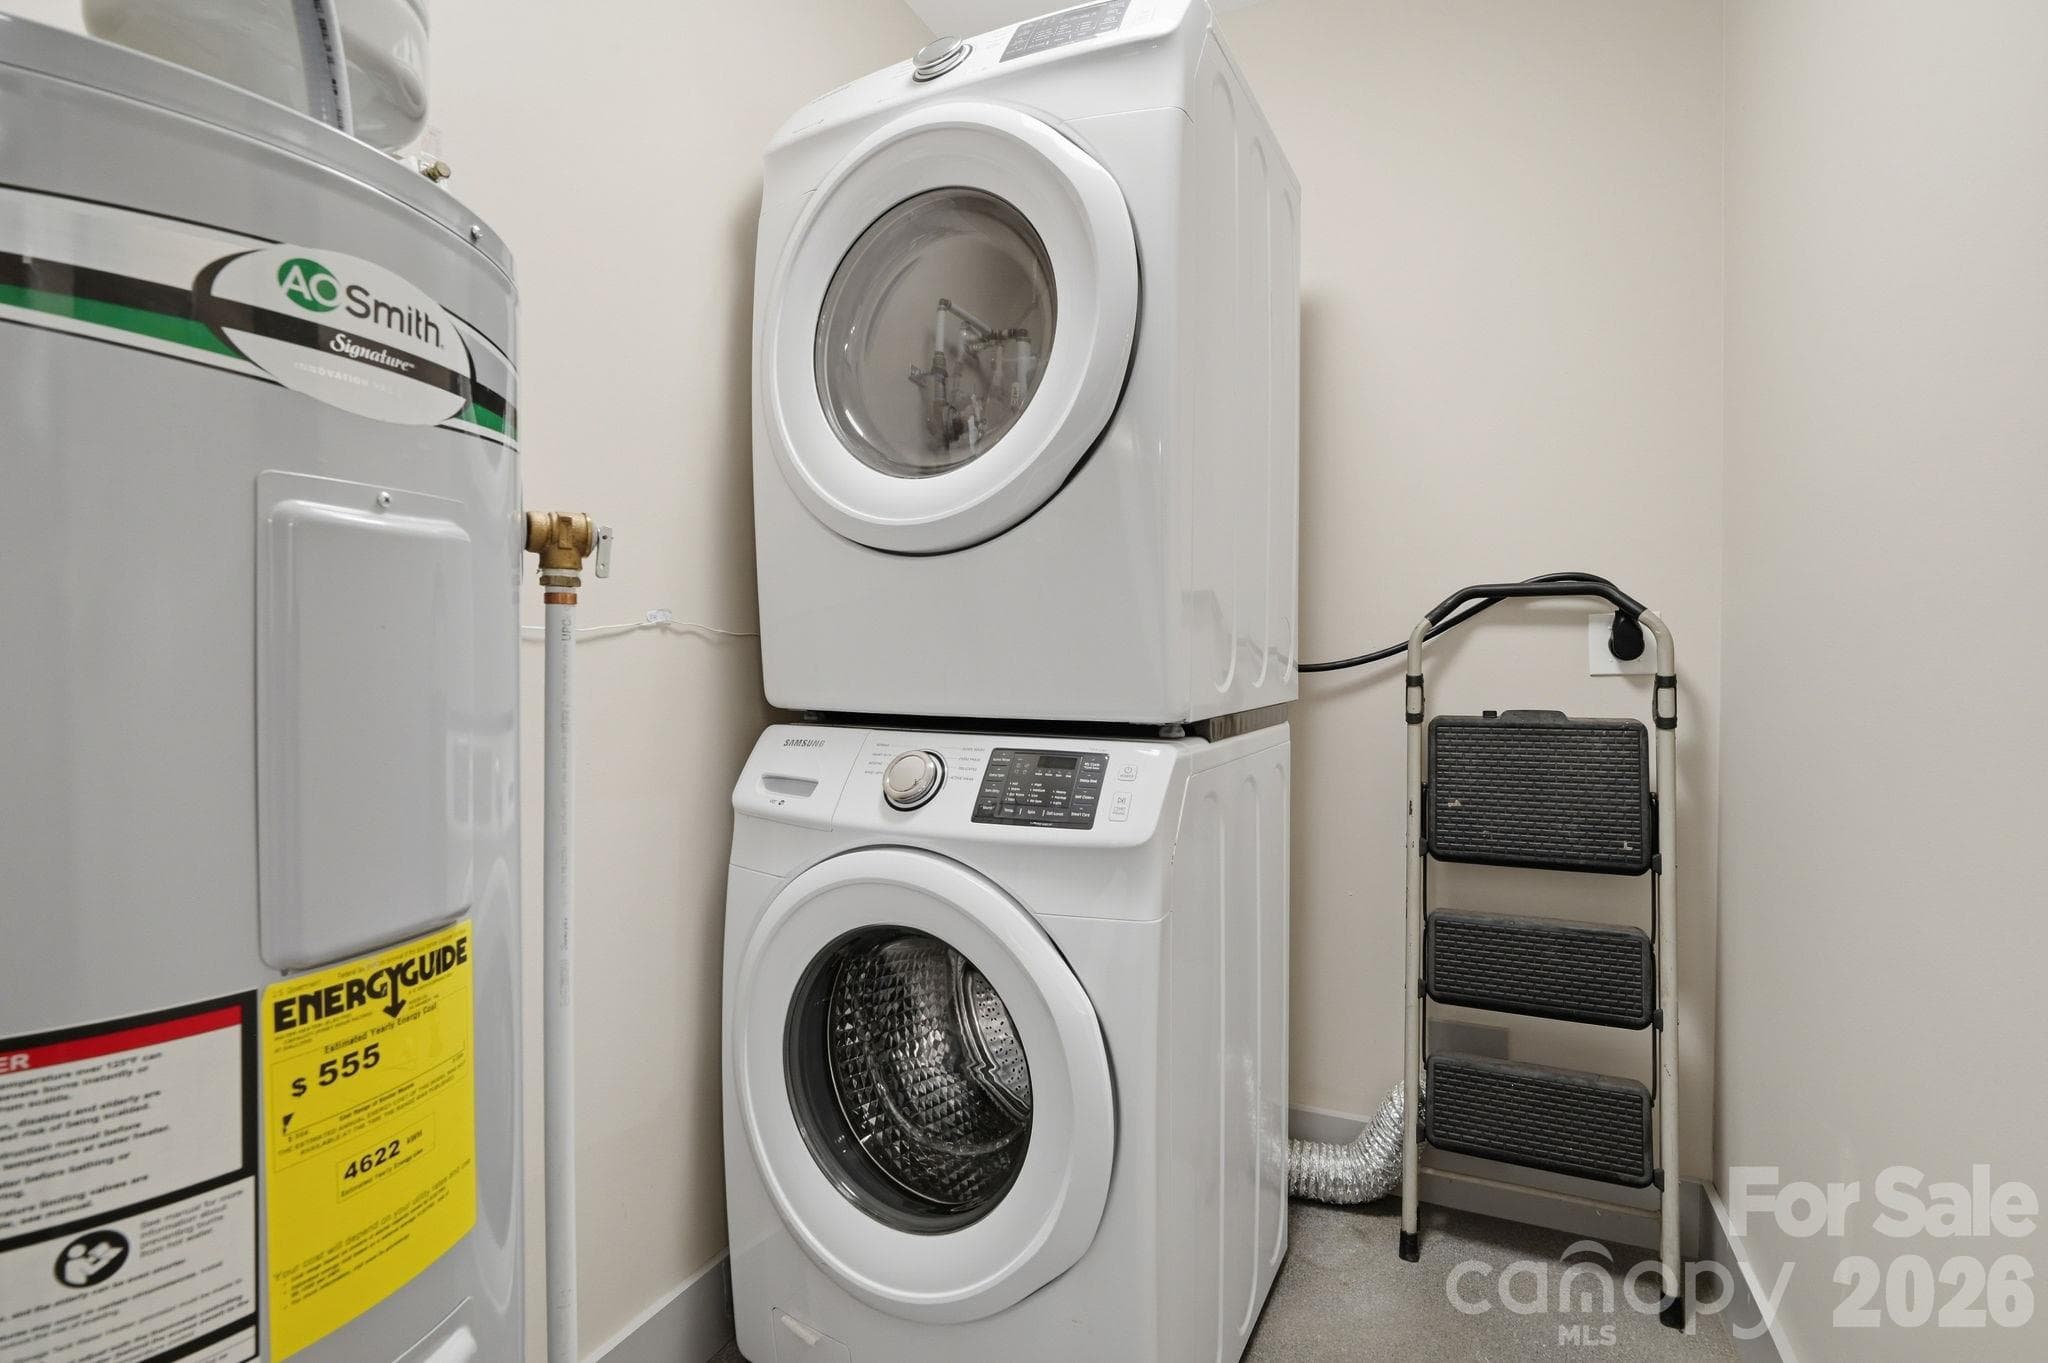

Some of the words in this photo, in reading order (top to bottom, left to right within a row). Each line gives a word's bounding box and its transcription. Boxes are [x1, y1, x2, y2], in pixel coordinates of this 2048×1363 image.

[345, 284, 440, 348] Smith
[329, 333, 412, 371] Signature
[783, 739, 826, 747] SAMSUNG
[274, 937, 467, 1033] ENERGYGUIDE
[292, 1077, 307, 1098] $
[318, 1042, 381, 1087] 555
[343, 1139, 401, 1180] 4622
